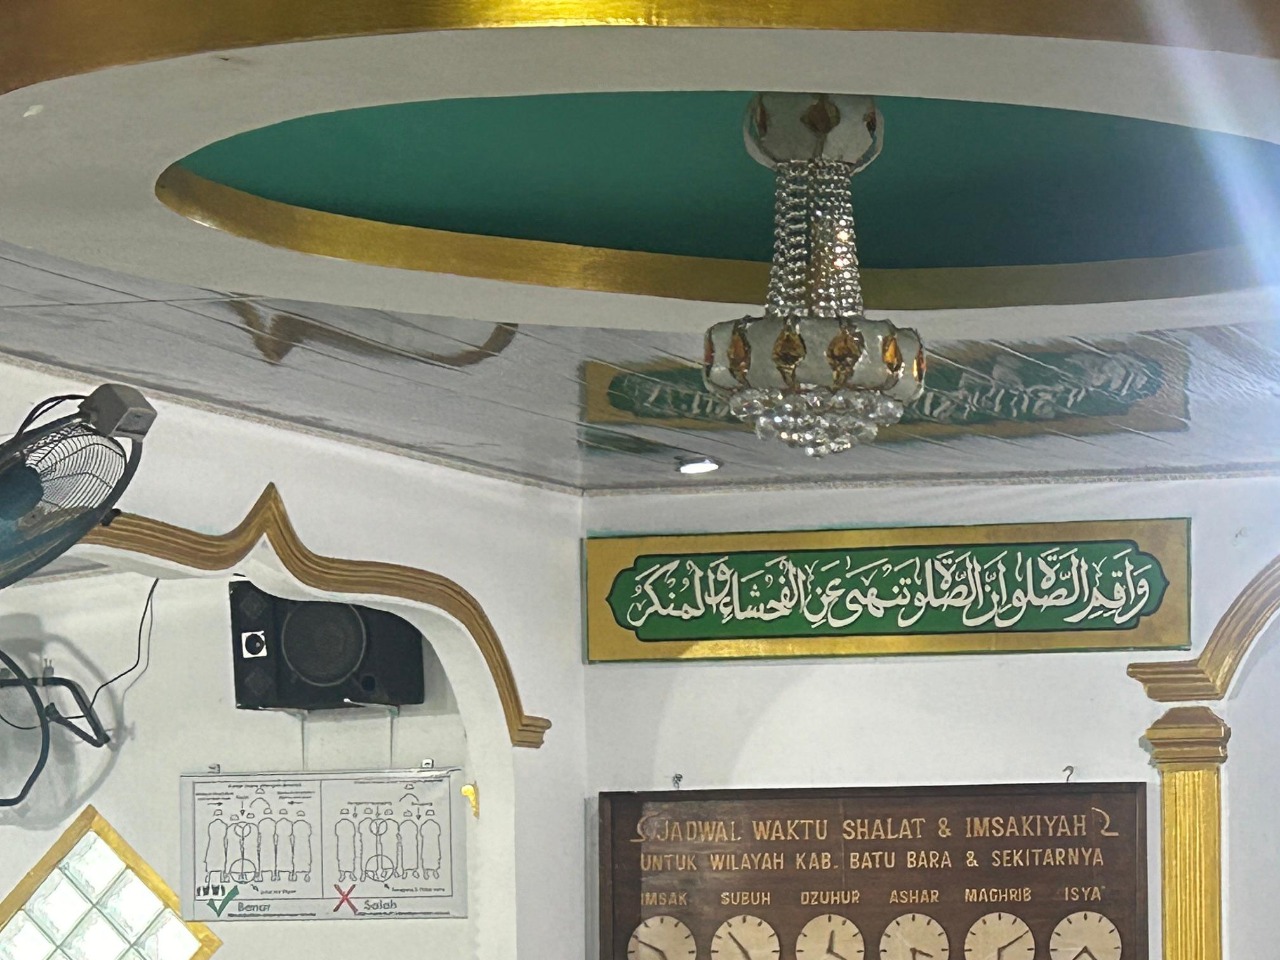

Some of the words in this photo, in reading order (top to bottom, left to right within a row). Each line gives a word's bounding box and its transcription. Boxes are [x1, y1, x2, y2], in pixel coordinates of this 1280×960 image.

[656, 820, 742, 842] JADWAL
[752, 819, 828, 841] WAKTU
[842, 817, 926, 841] SHALAT
[938, 817, 952, 838] &
[965, 814, 1087, 838] IMSAKIYAH
[640, 853, 698, 871] UNTUK
[710, 852, 784, 870] WILAYAH
[796, 852, 839, 870] KAB.
[850, 851, 896, 870] BATU
[907, 850, 953, 869] BARA
[966, 851, 979, 868] &
[991, 847, 1104, 868] SEKITARNYA
[641, 891, 688, 906] IMSAK
[720, 891, 771, 906] SUBUH
[800, 890, 861, 906] DZUHUR
[889, 889, 940, 904] ASHAR
[965, 887, 1032, 902] MAGHRIB
